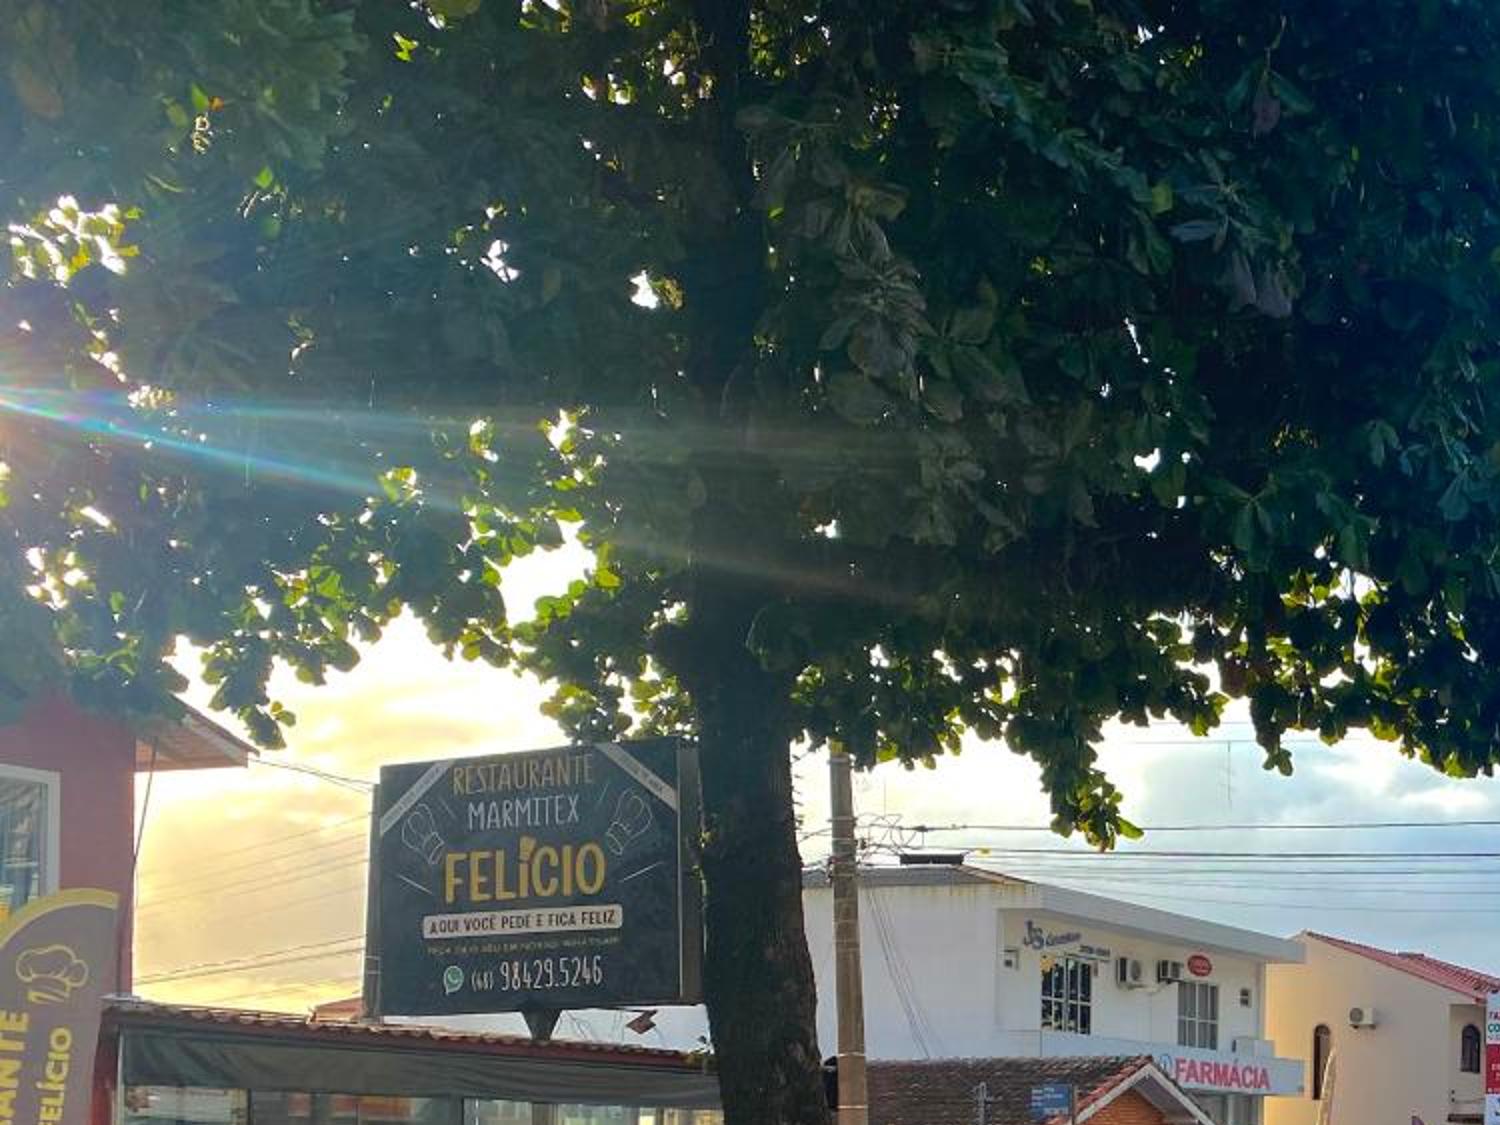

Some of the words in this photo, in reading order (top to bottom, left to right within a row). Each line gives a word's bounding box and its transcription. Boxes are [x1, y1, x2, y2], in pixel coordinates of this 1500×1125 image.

[453, 753, 593, 796] RESTAURANTE
[468, 794, 579, 831] MARMITEX
[429, 919, 460, 935] AQUI
[501, 914, 532, 929] PEDE
[535, 913, 543, 927] E
[547, 911, 577, 927] FICA
[581, 909, 617, 925] FELIZ
[1175, 1057, 1271, 1090] FARMÁCIA
